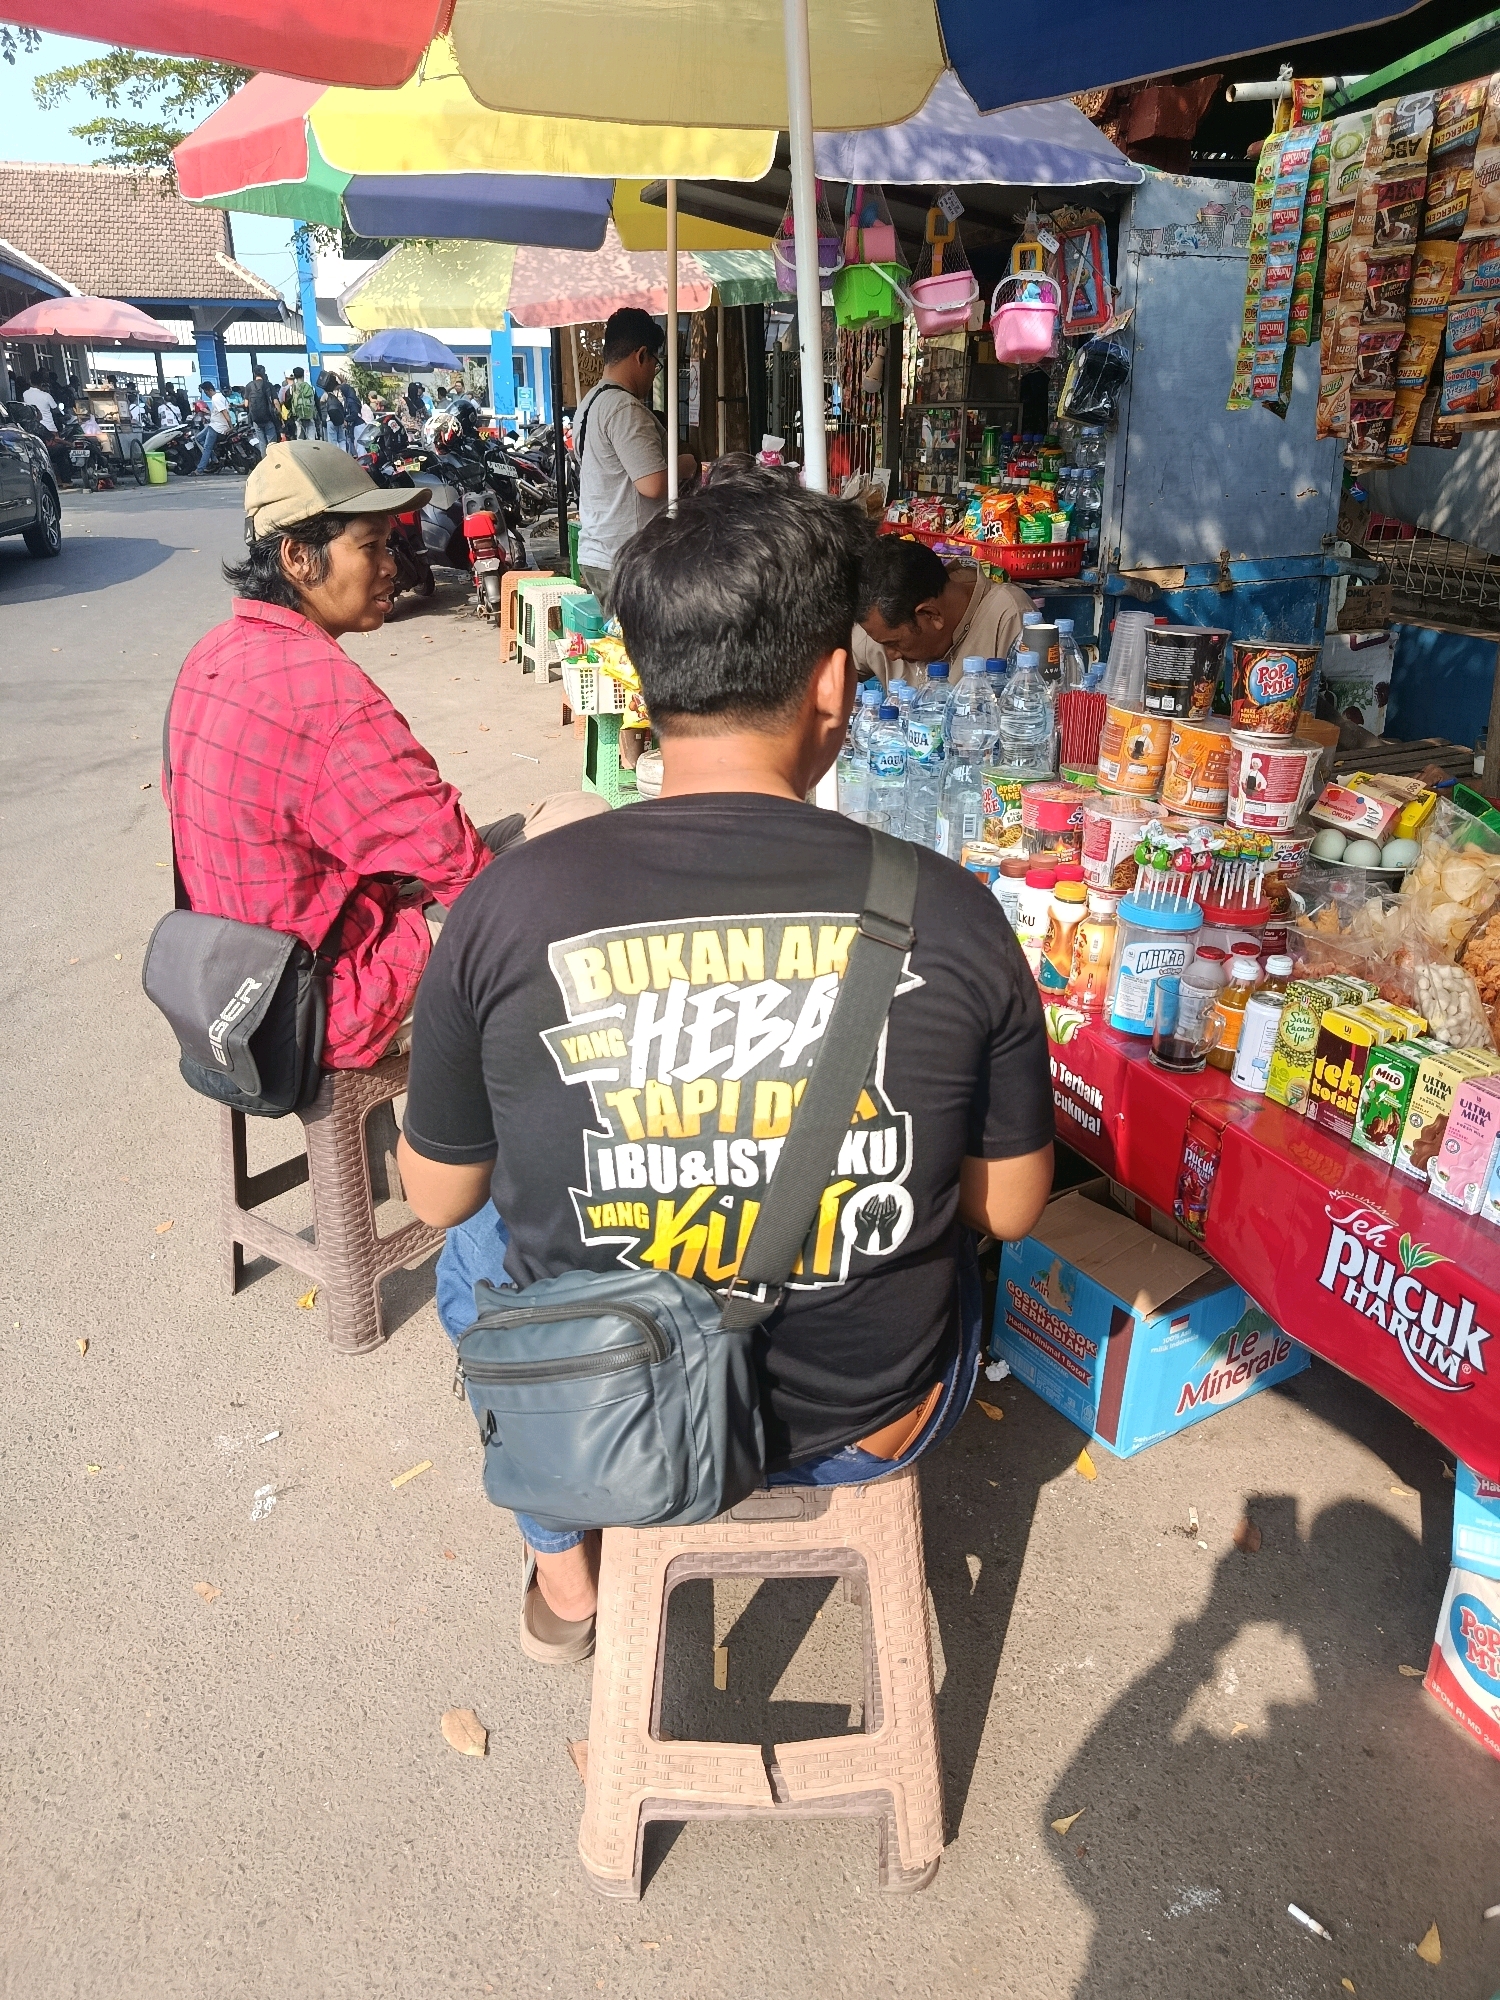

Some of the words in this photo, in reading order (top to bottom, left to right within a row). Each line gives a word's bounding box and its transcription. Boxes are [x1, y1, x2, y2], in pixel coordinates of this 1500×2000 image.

[1425, 200, 1464, 224] ENERGEN
[1257, 663, 1288, 685] POP
[1261, 674, 1294, 697] MIE
[880, 754, 904, 767] AQUA
[999, 792, 1020, 802] TIME
[563, 926, 765, 1004] BUKAN
[208, 976, 263, 1067] EIGER
[1283, 1020, 1316, 1039] Kacang
[1290, 1011, 1312, 1025] Sari
[561, 1026, 628, 1064] YANG
[1059, 1062, 1104, 1112] Terbaik
[1314, 1055, 1362, 1098] teh
[1375, 1067, 1401, 1086] MILO
[1422, 1073, 1452, 1095] ULTRA
[1311, 1078, 1357, 1115] kotak
[1423, 1084, 1448, 1102] MILK
[606, 1078, 742, 1142] TAPI
[1052, 1087, 1101, 1137] cuknya!
[1459, 1098, 1492, 1122] ULTRA
[1461, 1109, 1487, 1128] MILK
[1187, 1160, 1211, 1183] HARUM
[587, 1200, 650, 1230] YANG
[1328, 1189, 1390, 1217] MINUMAN
[1324, 1204, 1393, 1247] Teh
[1006, 1280, 1097, 1355] GOSOK-GOSOK
[1013, 1299, 1085, 1357] BERHADIAH
[1008, 1315, 1032, 1338] Hadiah
[1032, 1332, 1061, 1363] Minimal
[1066, 1359, 1086, 1379] Botol
[1169, 1333, 1199, 1350] Indonesia
[1226, 1331, 1260, 1366] Le
[1343, 1278, 1474, 1391] HARUM
[1176, 1336, 1292, 1415] Minerale
[1460, 1606, 1500, 1653] POP
[1466, 1638, 1500, 1680] MI
[1455, 1708, 1466, 1724] RI
[1467, 1718, 1482, 1736] MD
